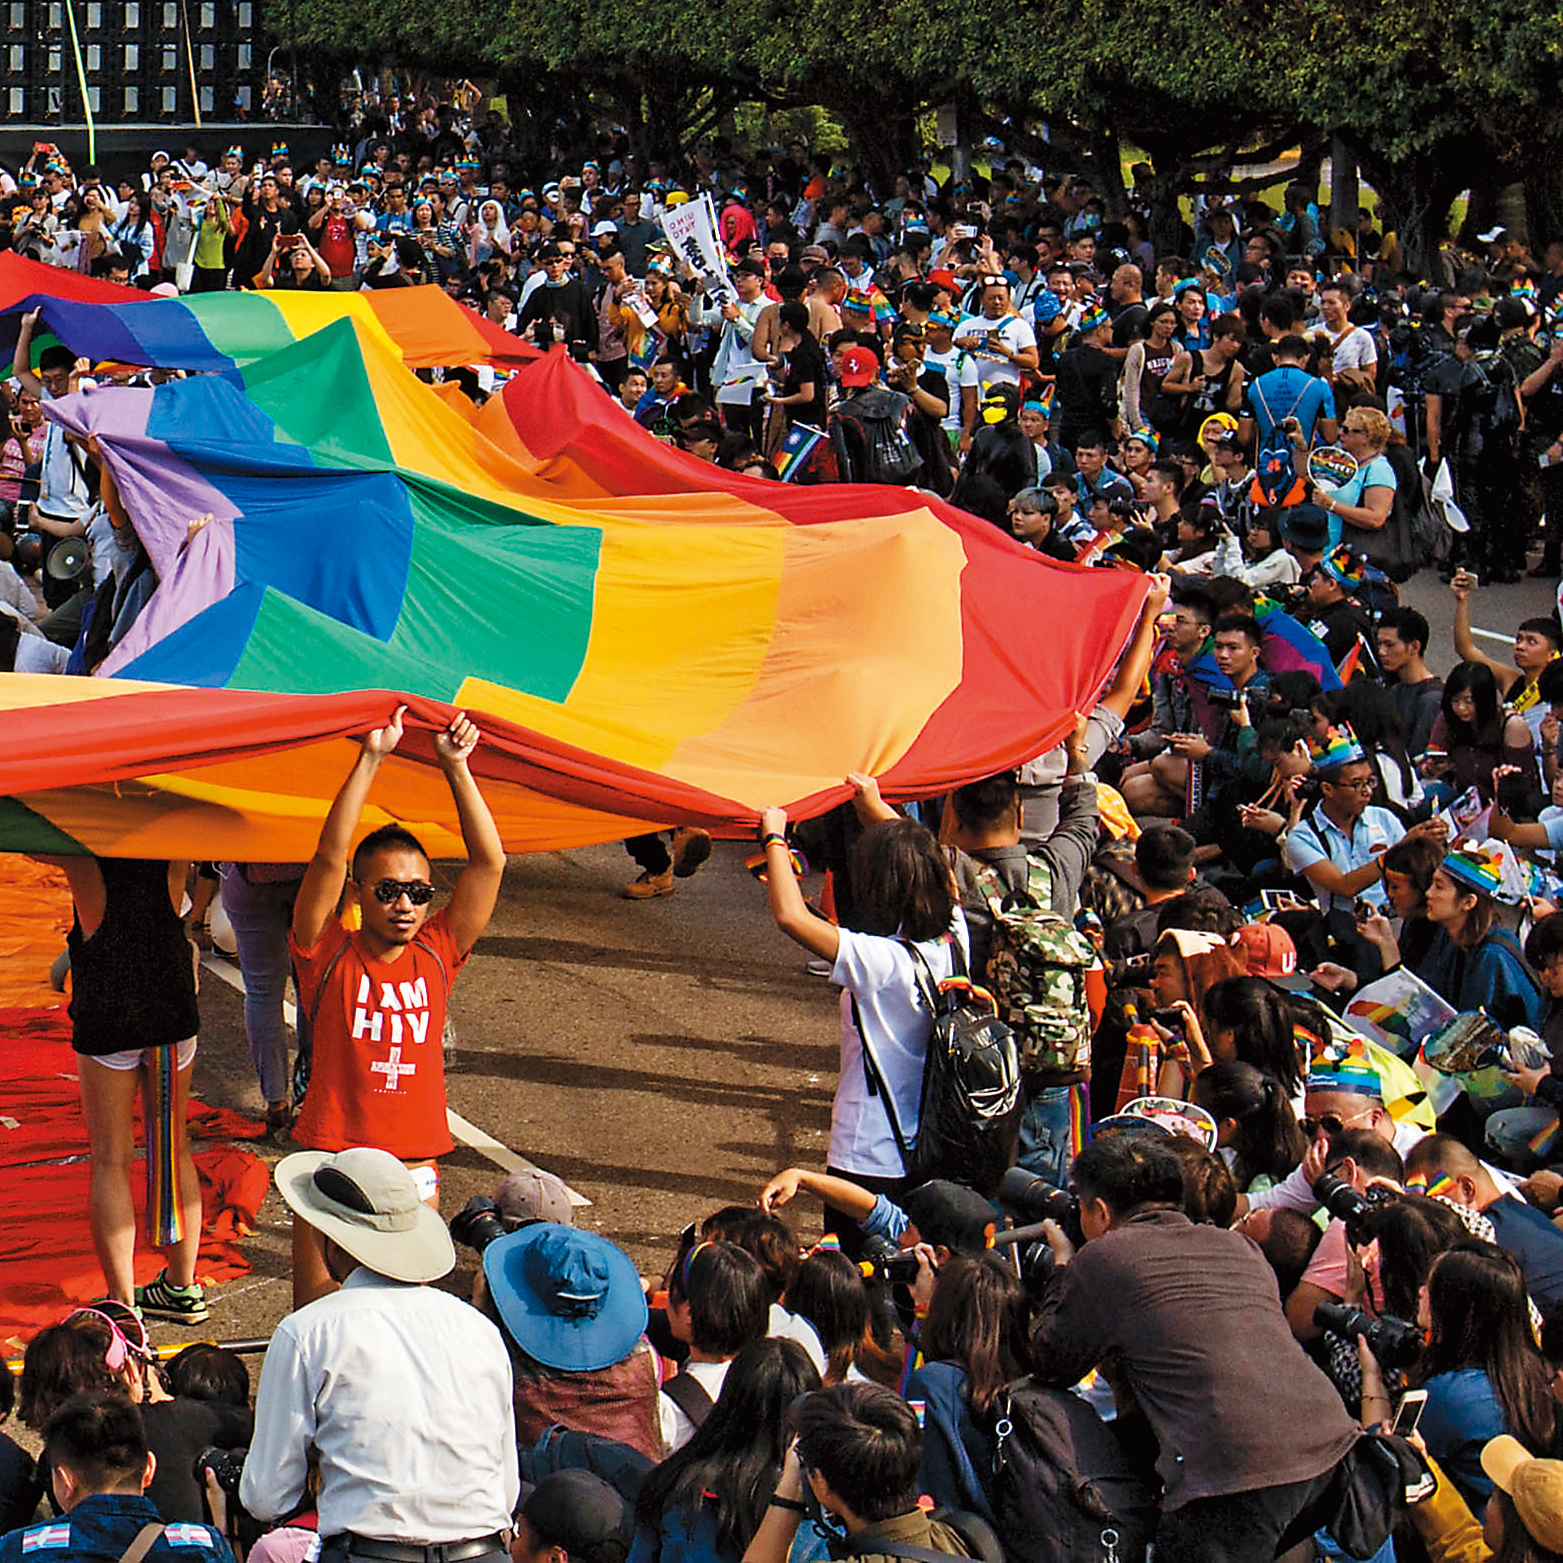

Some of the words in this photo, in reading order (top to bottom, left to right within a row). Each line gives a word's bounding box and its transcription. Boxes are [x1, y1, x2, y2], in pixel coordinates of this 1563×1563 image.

[357, 974, 370, 1003] I
[380, 977, 428, 1011] AM
[352, 1007, 430, 1044] HIV
